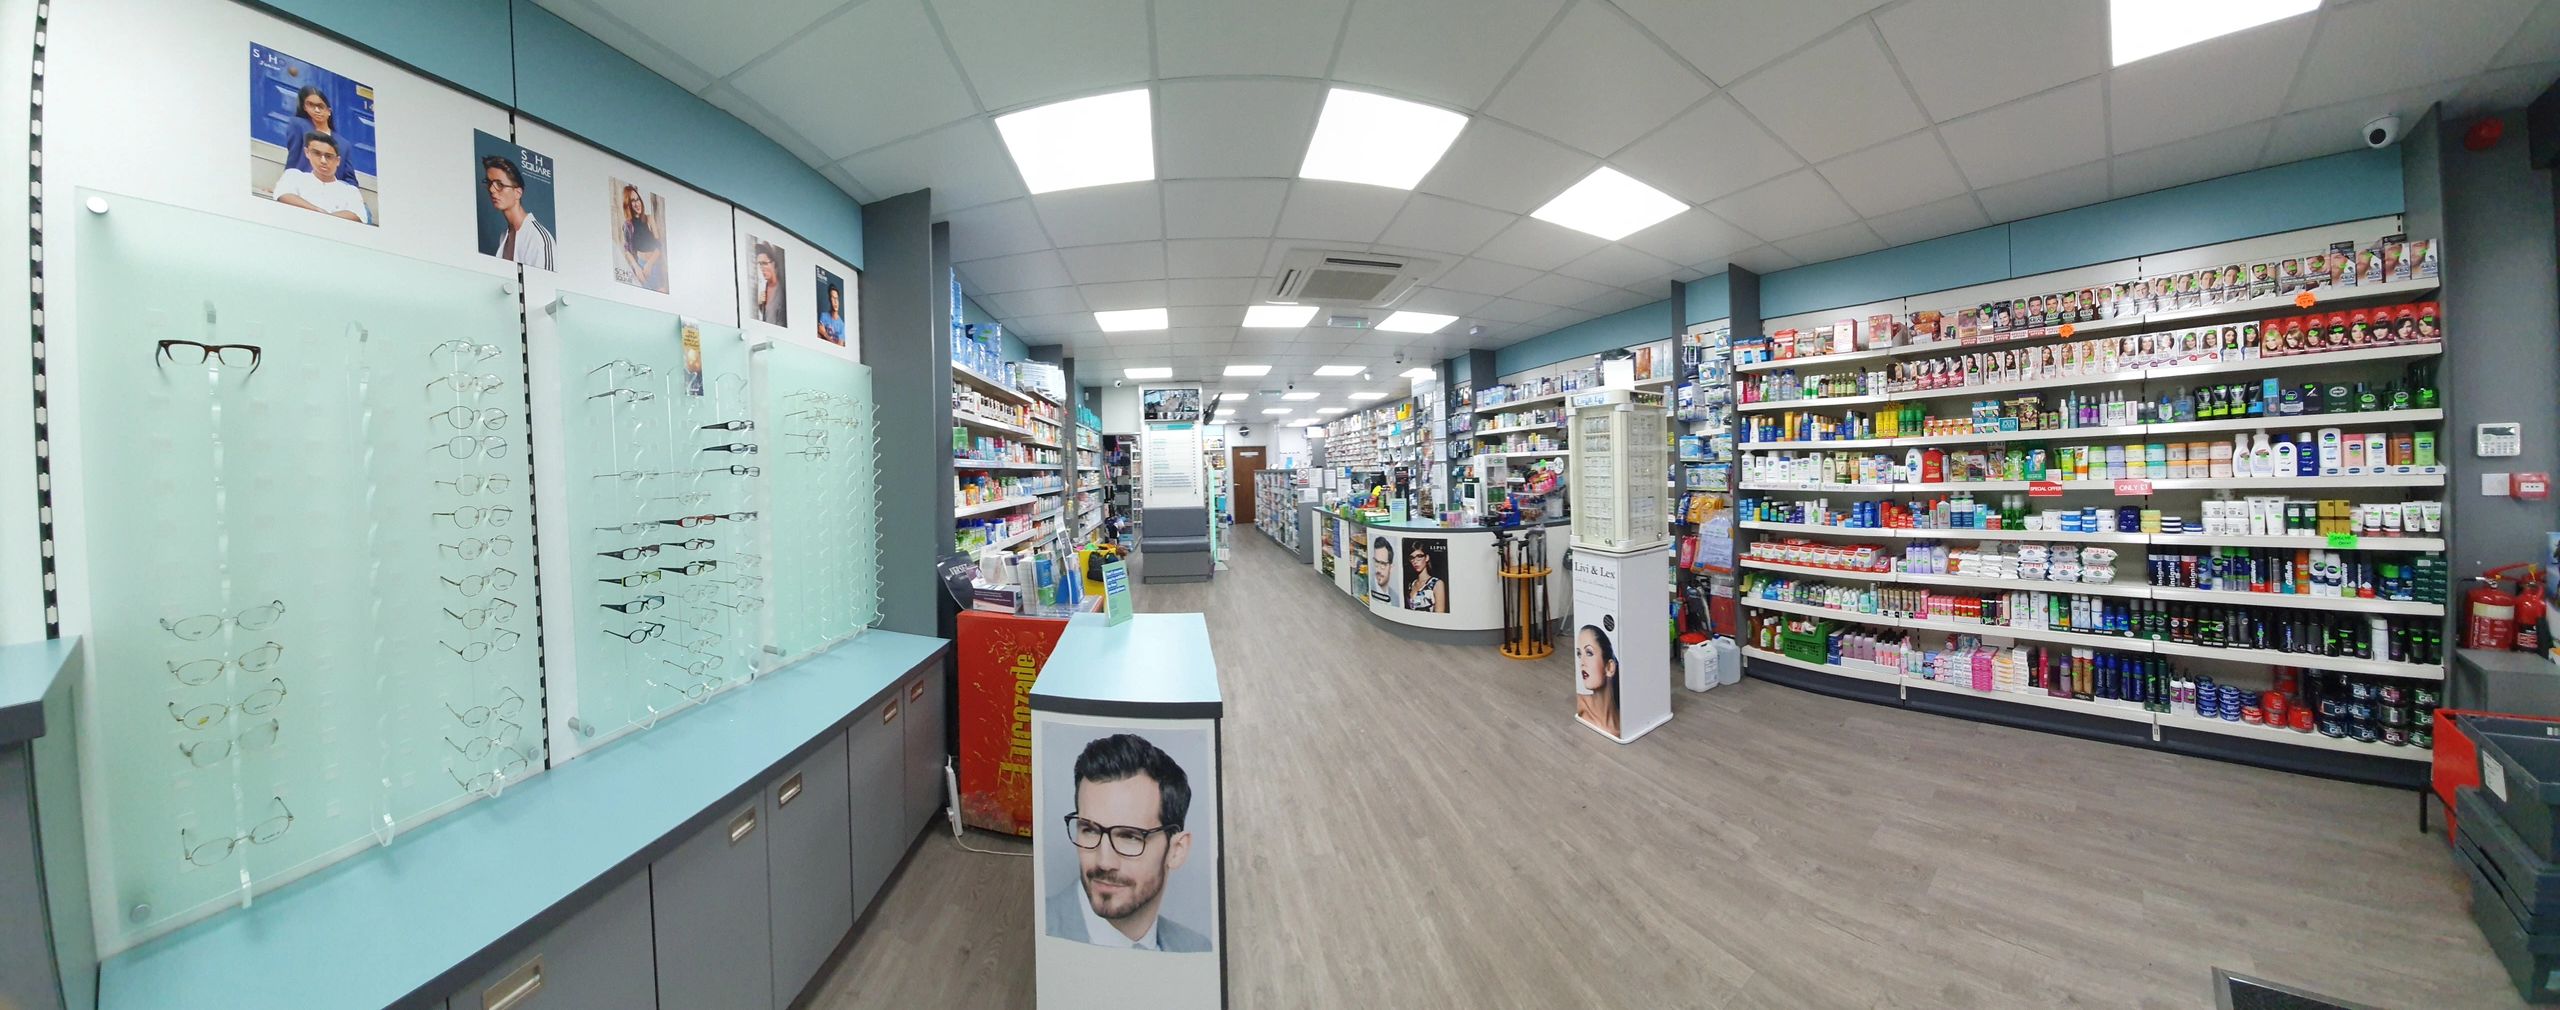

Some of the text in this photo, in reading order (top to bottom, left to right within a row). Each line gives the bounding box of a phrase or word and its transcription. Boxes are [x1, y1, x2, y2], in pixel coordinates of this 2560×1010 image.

[521, 160, 551, 178] SQUARE
[1574, 561, 1616, 579] Livi & Lex
[2156, 561, 2164, 586] insignia
[2168, 562, 2176, 587] insignia
[2189, 562, 2198, 588] insignia
[2285, 560, 2293, 586] Gillette
